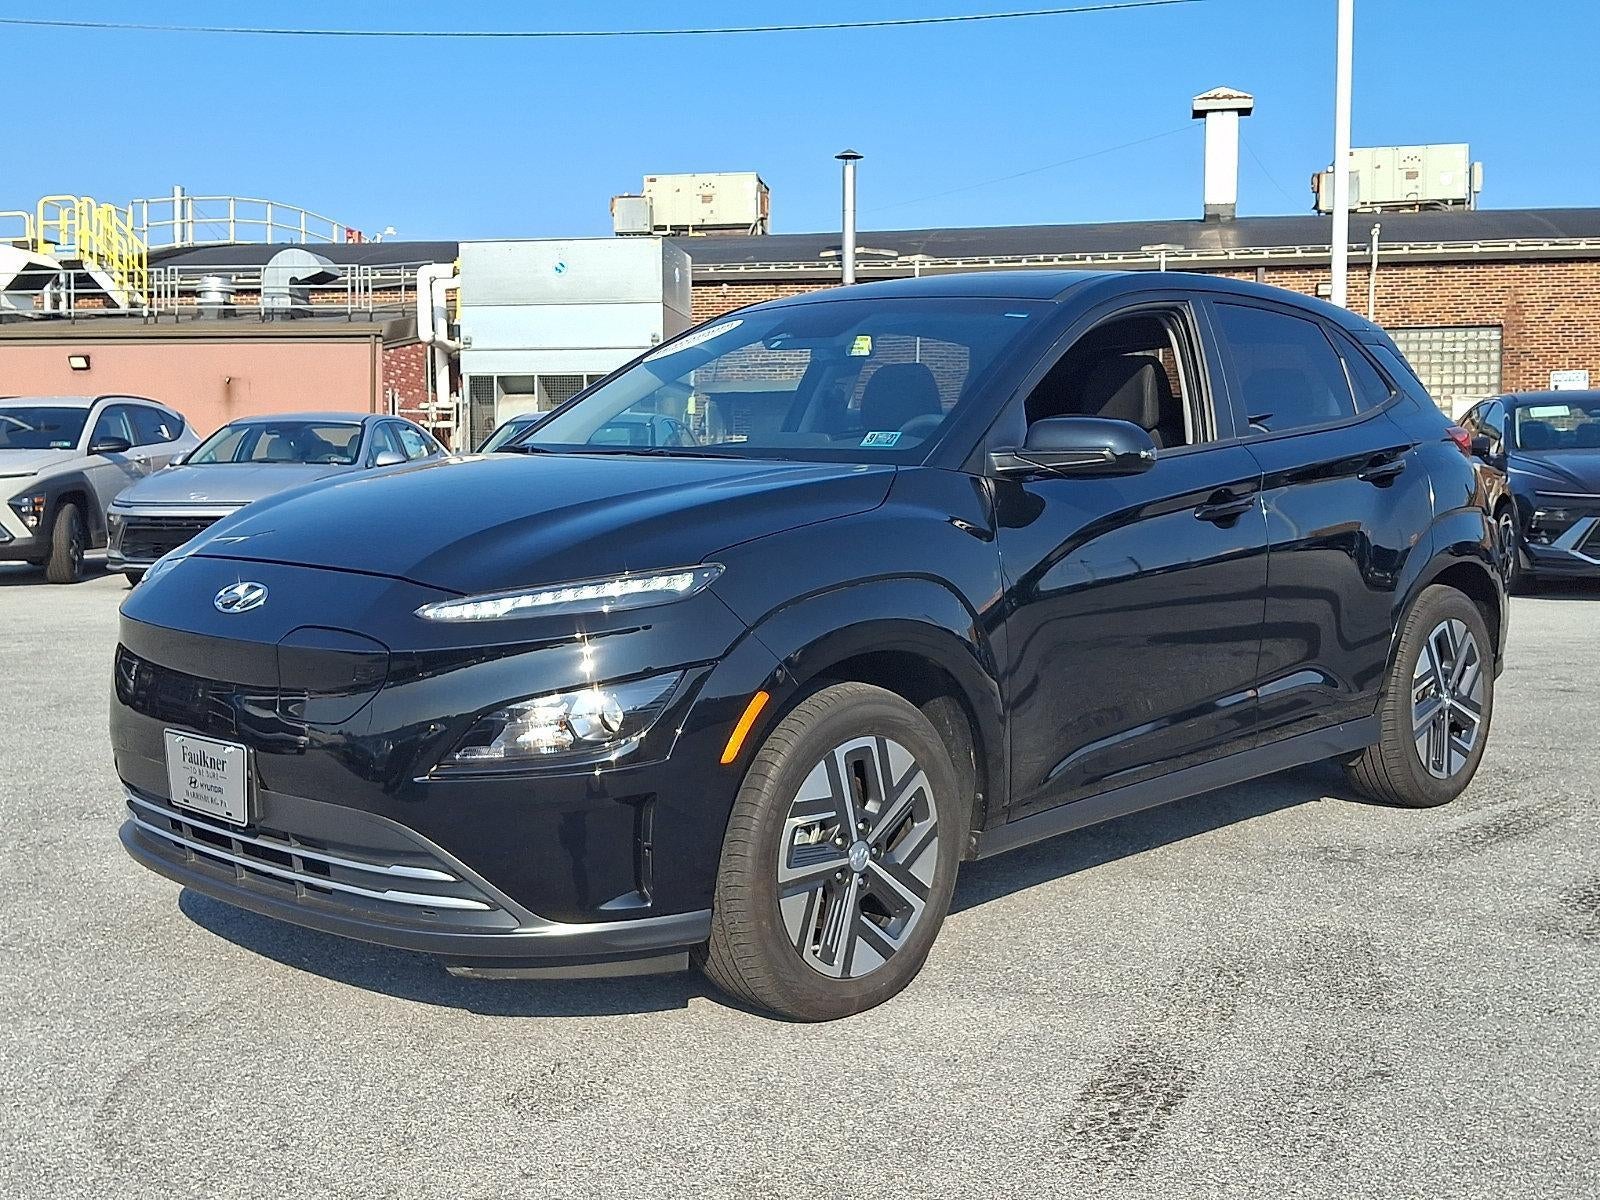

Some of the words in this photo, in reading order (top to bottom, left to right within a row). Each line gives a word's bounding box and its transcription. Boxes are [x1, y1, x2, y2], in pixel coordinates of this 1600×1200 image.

[866, 433, 877, 443] 9
[181, 745, 227, 772] Faulkner
[200, 782, 224, 795] HYUNDAI
